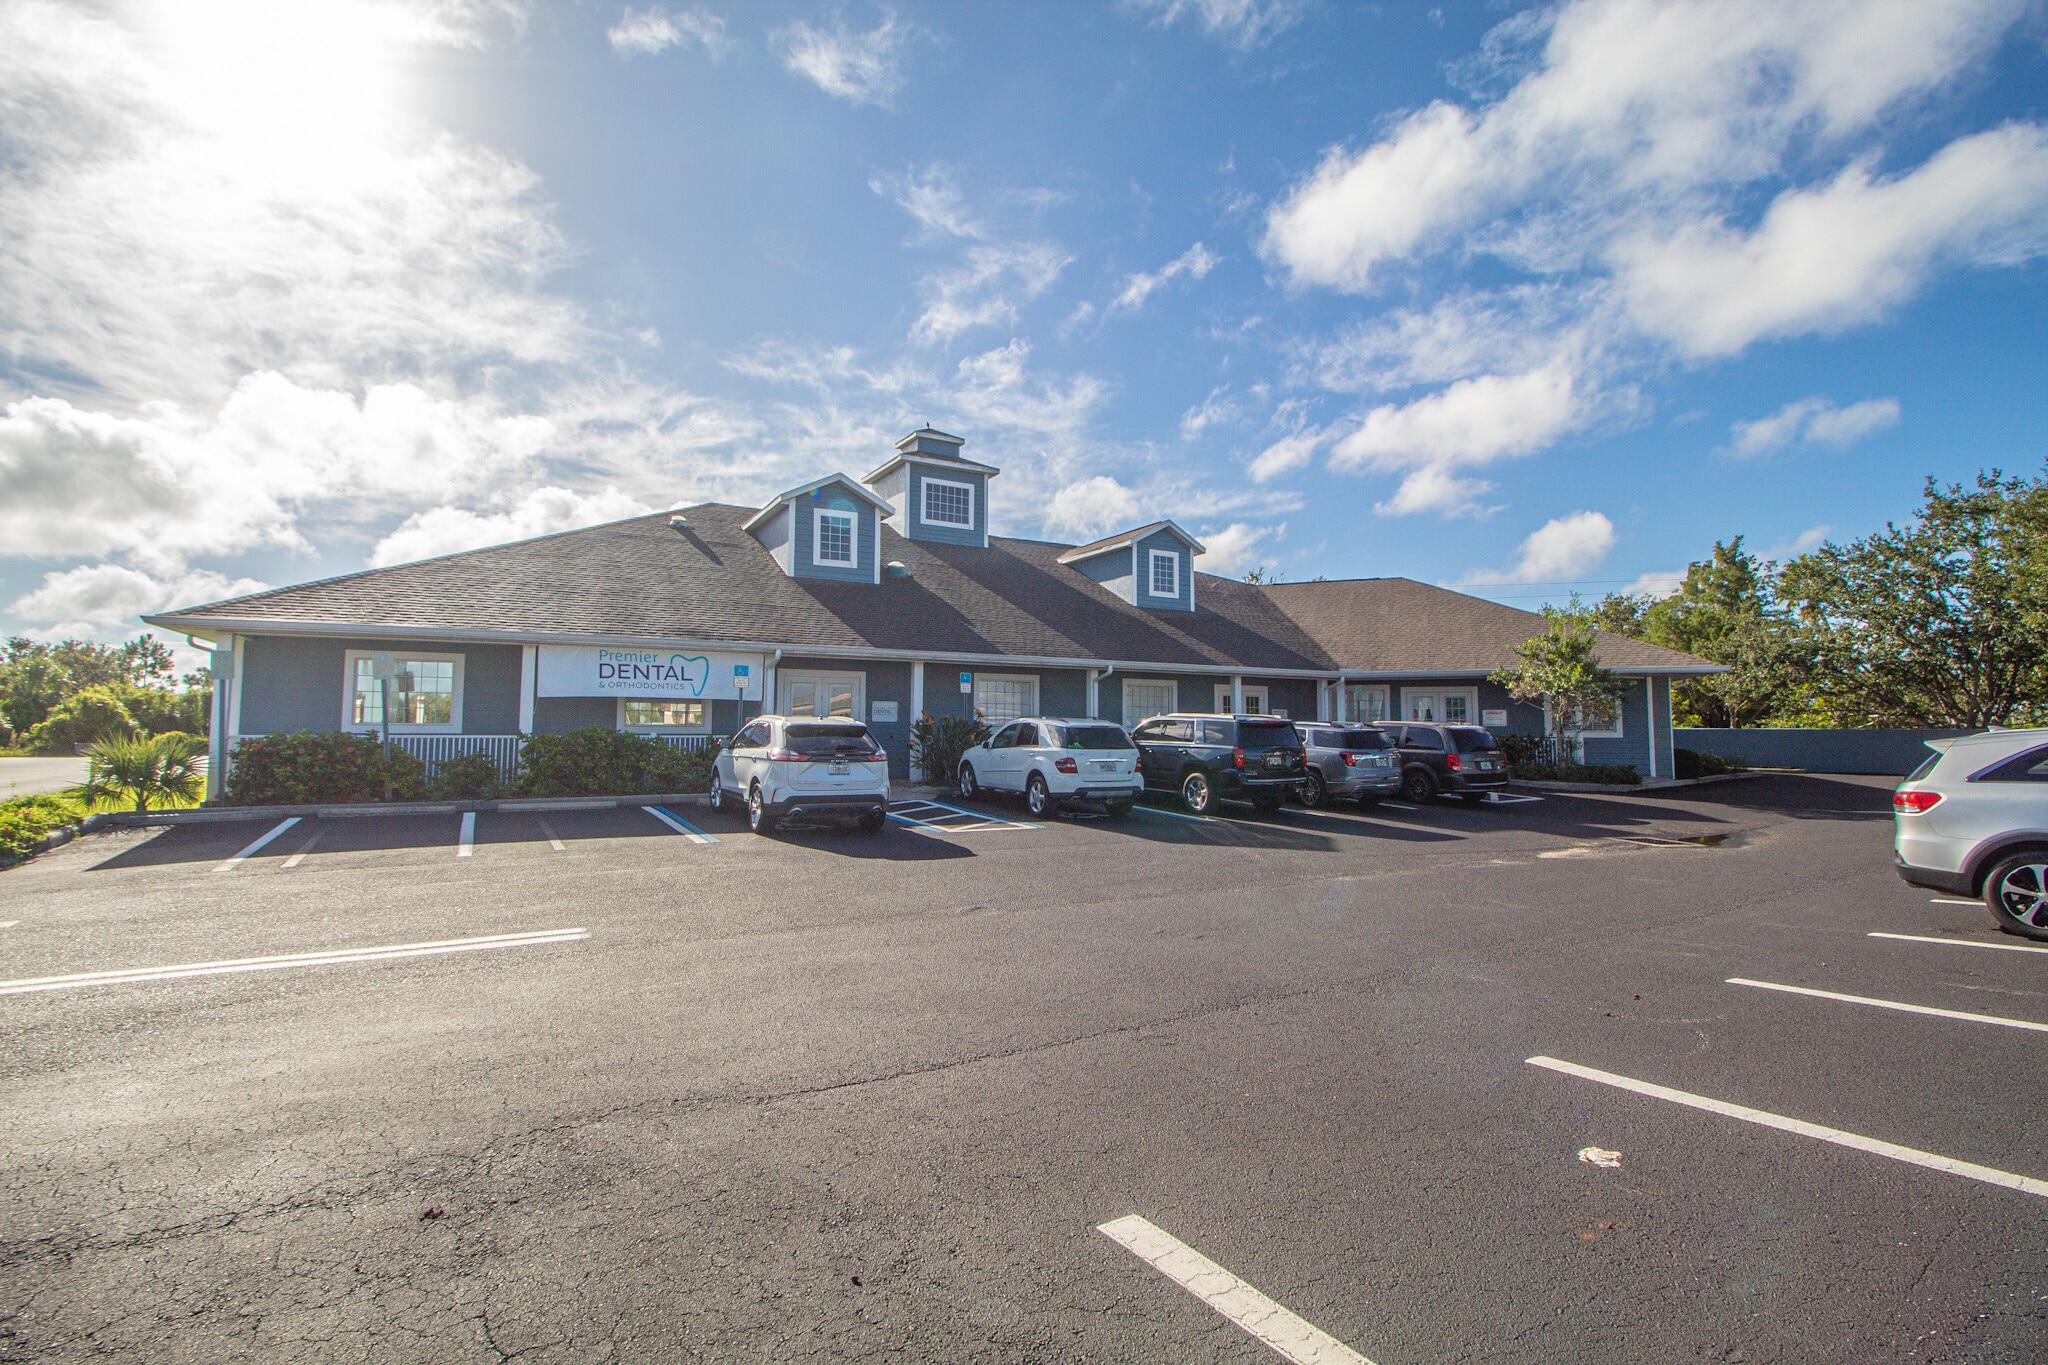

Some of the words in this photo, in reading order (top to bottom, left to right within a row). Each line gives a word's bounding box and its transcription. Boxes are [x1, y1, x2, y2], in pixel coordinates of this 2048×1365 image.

[599, 649, 658, 663] Premier
[599, 663, 693, 681] DENTAL
[599, 681, 605, 689] &
[608, 681, 685, 690] ORTHODONTICS
